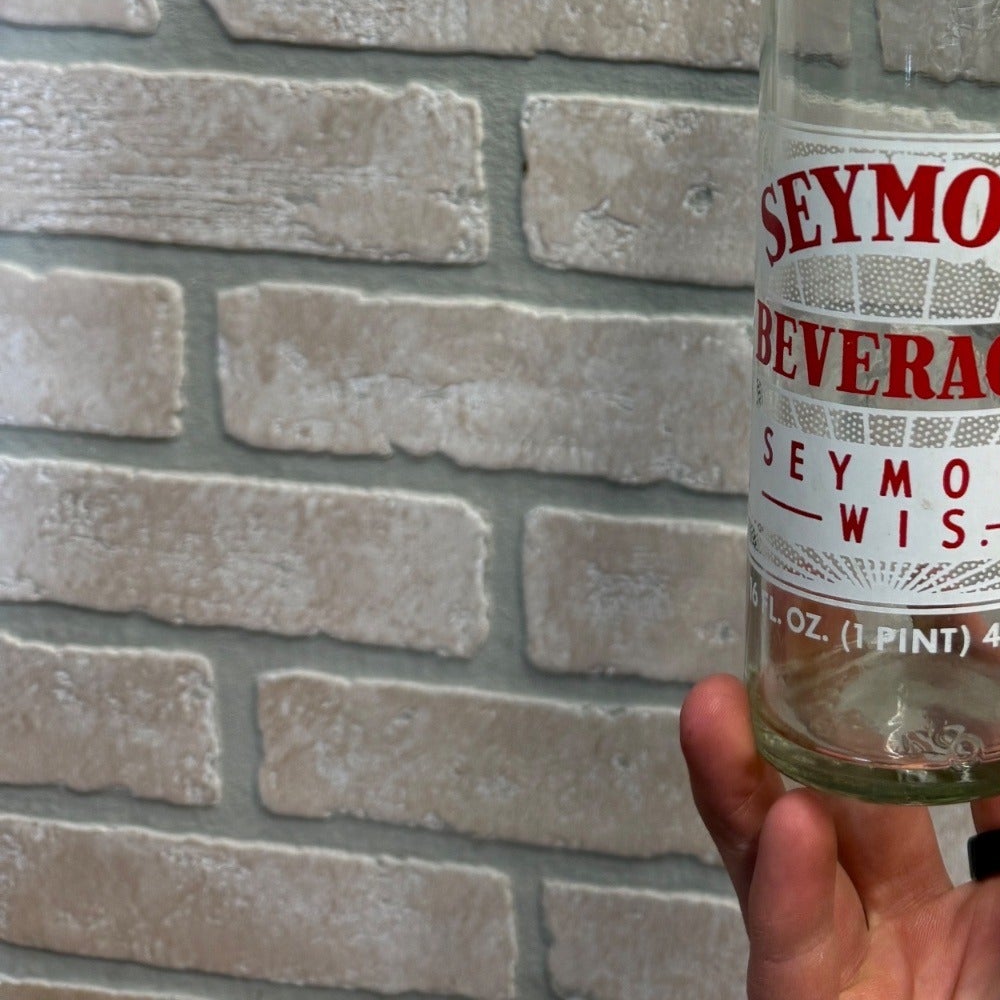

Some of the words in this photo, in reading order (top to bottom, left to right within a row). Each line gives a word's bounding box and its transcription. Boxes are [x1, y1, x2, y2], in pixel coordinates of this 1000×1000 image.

[840, 503, 988, 549] WIS.
[786, 606, 829, 642] OZ.
[841, 620, 864, 653] (1
[876, 624, 970, 657] PINT)
